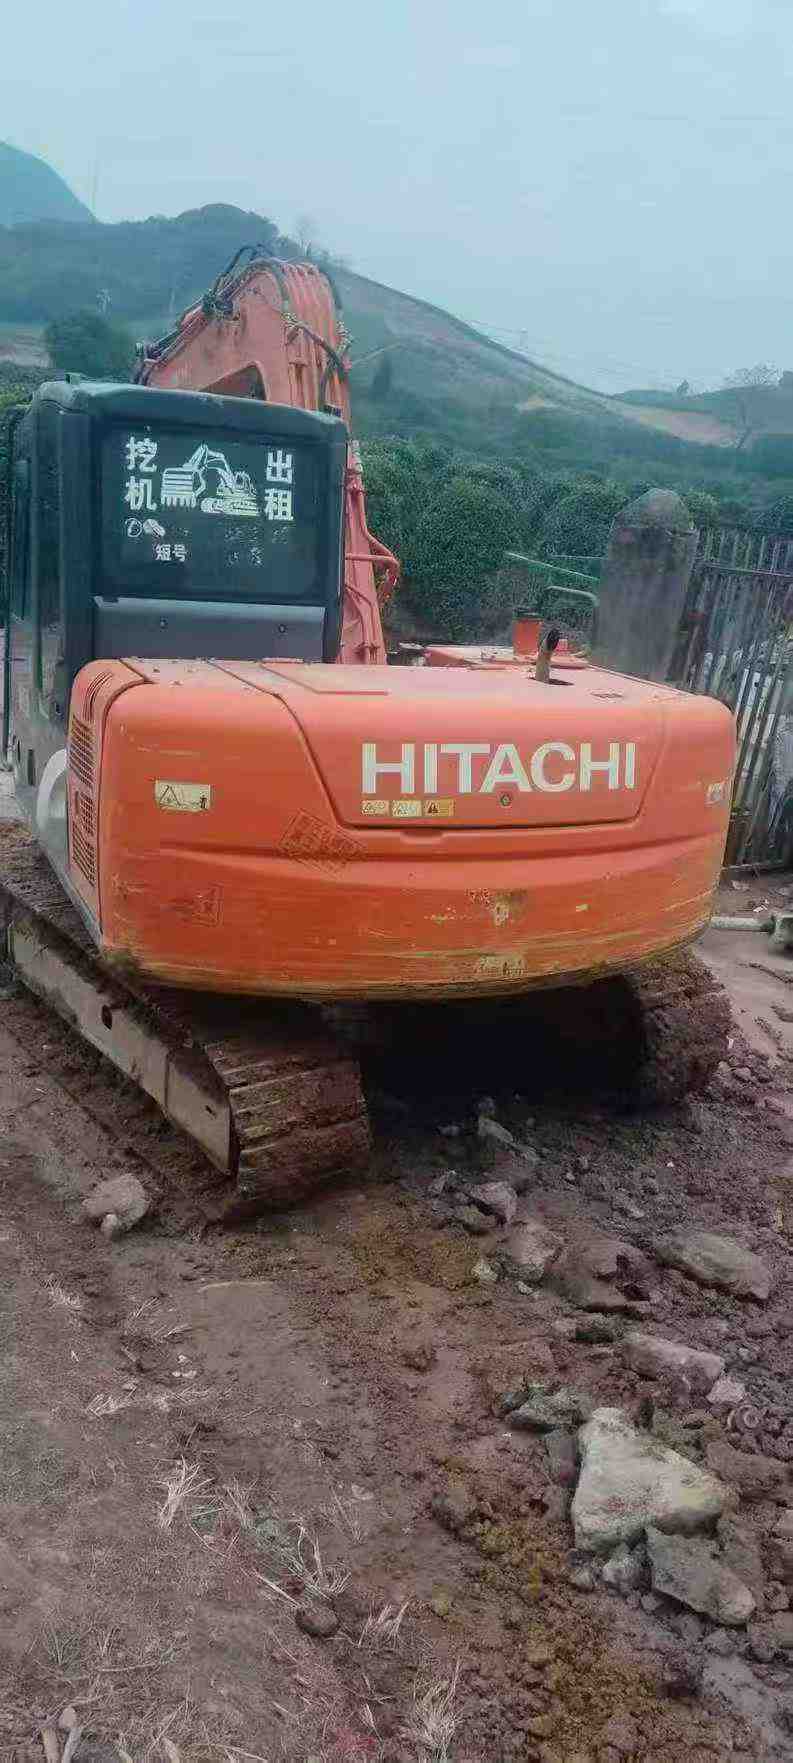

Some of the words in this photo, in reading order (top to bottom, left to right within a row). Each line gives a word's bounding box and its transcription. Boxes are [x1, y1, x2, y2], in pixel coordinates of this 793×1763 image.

[125, 436, 158, 511] 挖机
[264, 450, 294, 520] 出租
[155, 544, 188, 563] 短号
[361, 742, 636, 794] HITACHI
